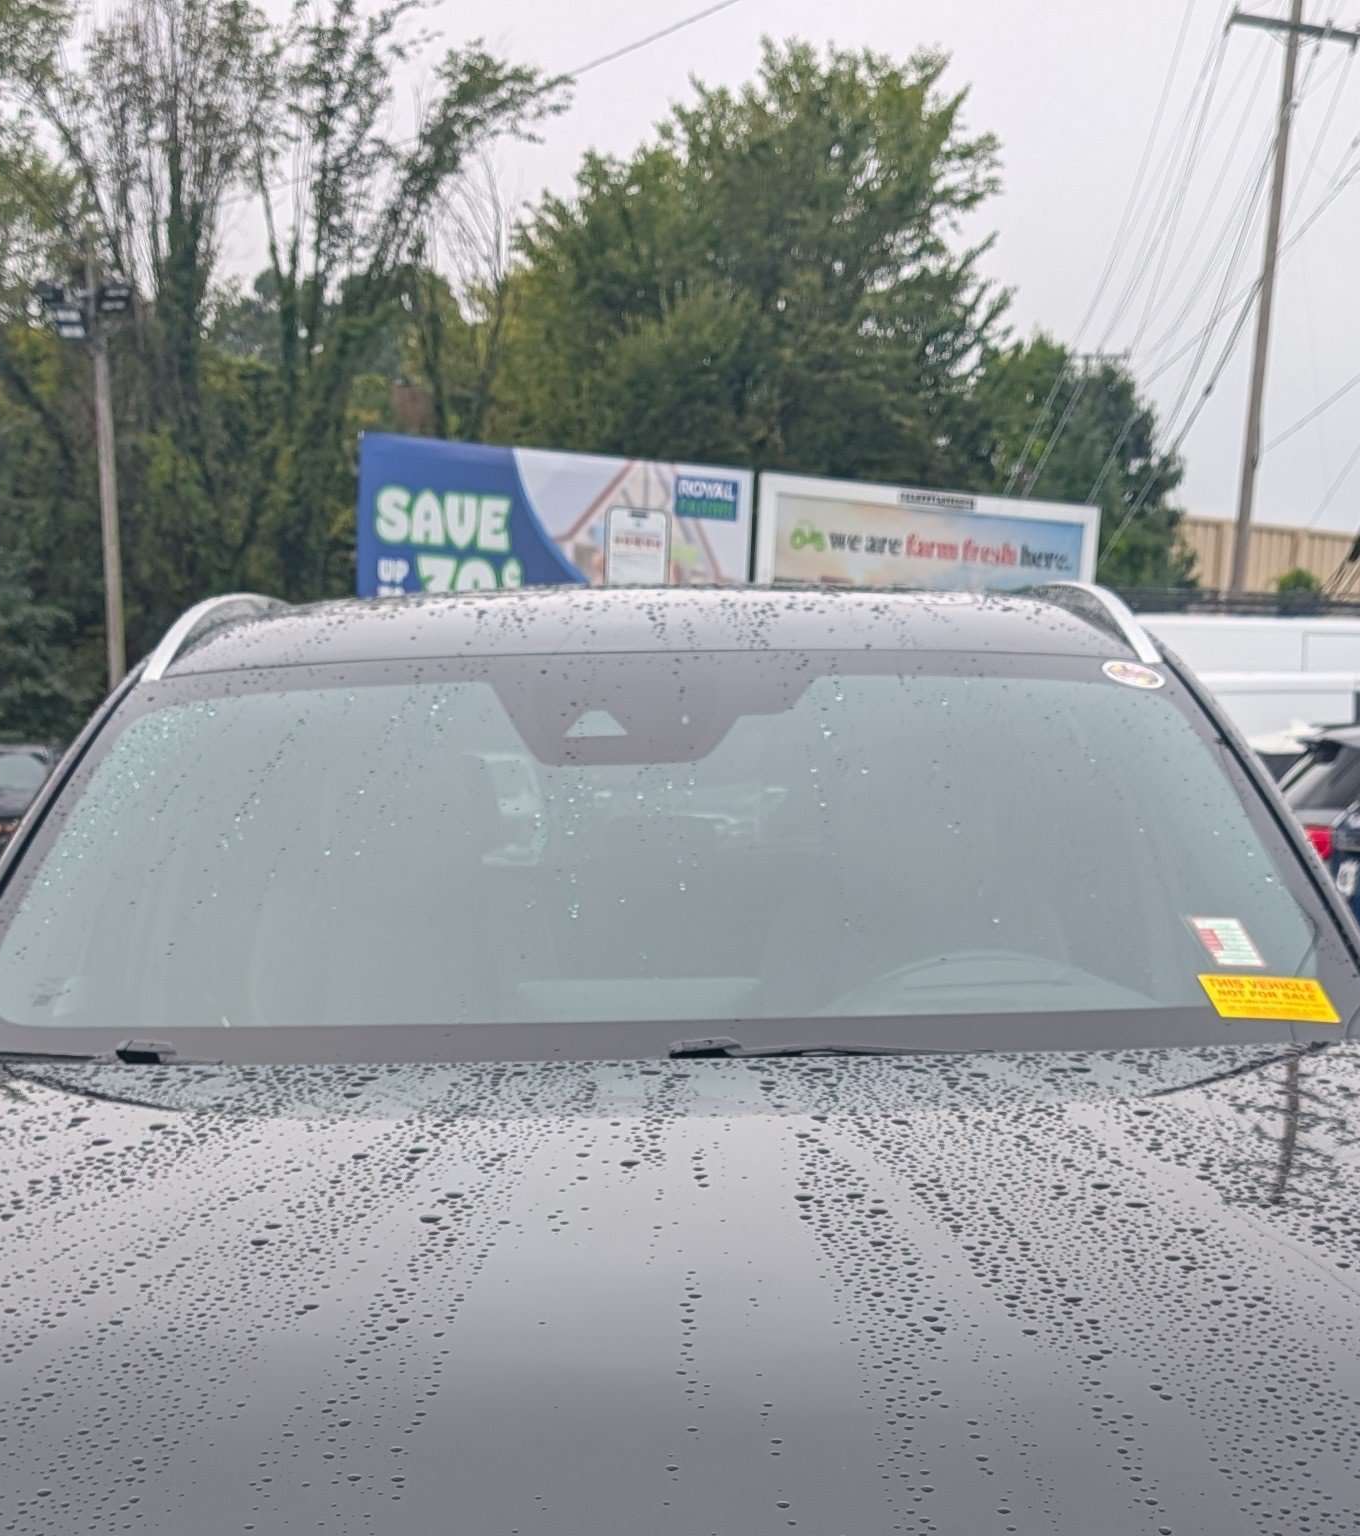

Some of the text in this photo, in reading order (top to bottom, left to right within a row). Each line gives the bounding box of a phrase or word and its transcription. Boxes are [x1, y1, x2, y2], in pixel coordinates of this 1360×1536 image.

[678, 479, 734, 502] ROYAL
[375, 485, 511, 553] SAVE
[828, 531, 1072, 571] we are farm fresh here.
[377, 557, 410, 583] UP
[1207, 978, 1316, 993] THIS VEHICLE
[1217, 989, 1317, 1002] NOT FOR SALE
